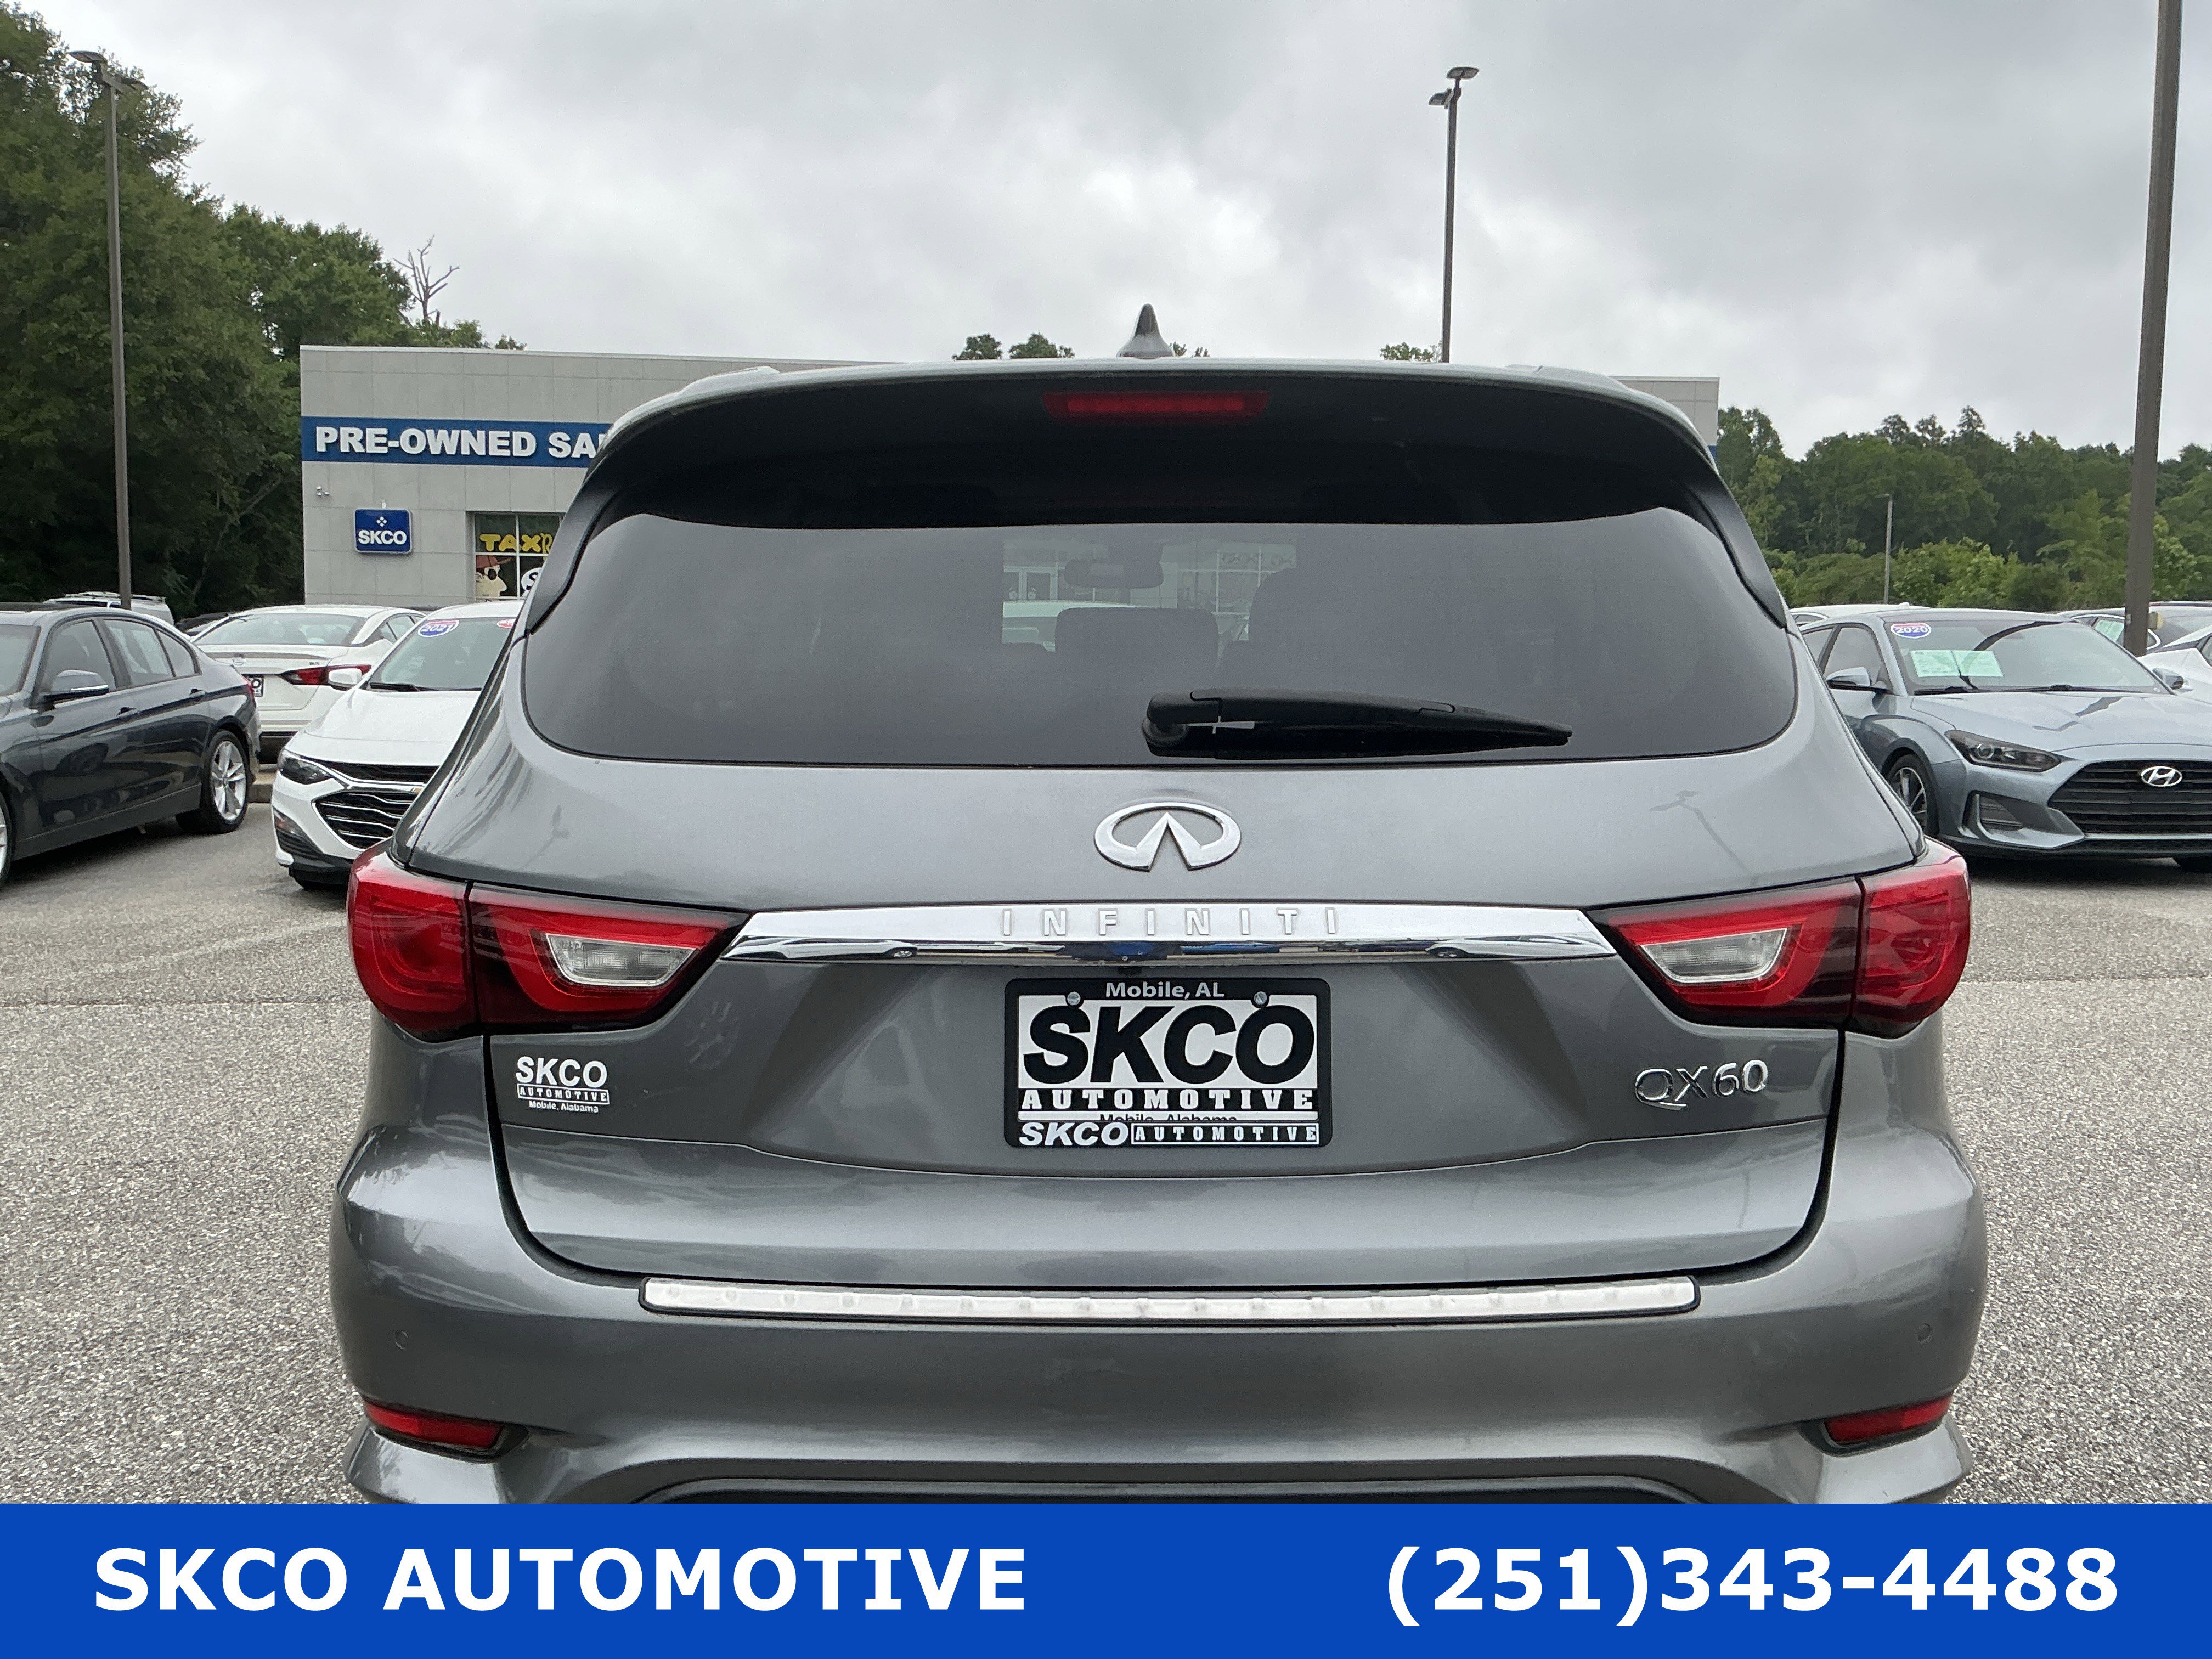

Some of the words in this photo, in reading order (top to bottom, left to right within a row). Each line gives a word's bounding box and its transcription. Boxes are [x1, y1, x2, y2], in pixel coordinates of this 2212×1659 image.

[315, 426, 537, 457] PRE-OWNED
[358, 529, 407, 545] SKCO
[421, 624, 455, 632] 2021
[1002, 908, 1337, 936] INFINITI
[1105, 981, 1190, 999] Mobile,
[1195, 982, 1225, 997] AL
[1023, 1005, 1315, 1084] SKCO
[515, 1056, 607, 1088] SKCO
[520, 1086, 607, 1102] AUTOMOTIVE
[1635, 1059, 1768, 1110] QX60
[529, 1101, 559, 1111] Mobile,
[561, 1103, 599, 1113] Alabama
[1022, 1088, 1313, 1110] AUTOMOTIVE
[1019, 1122, 1128, 1146] SKCO
[1135, 1126, 1317, 1141] AUTOMOTIVE
